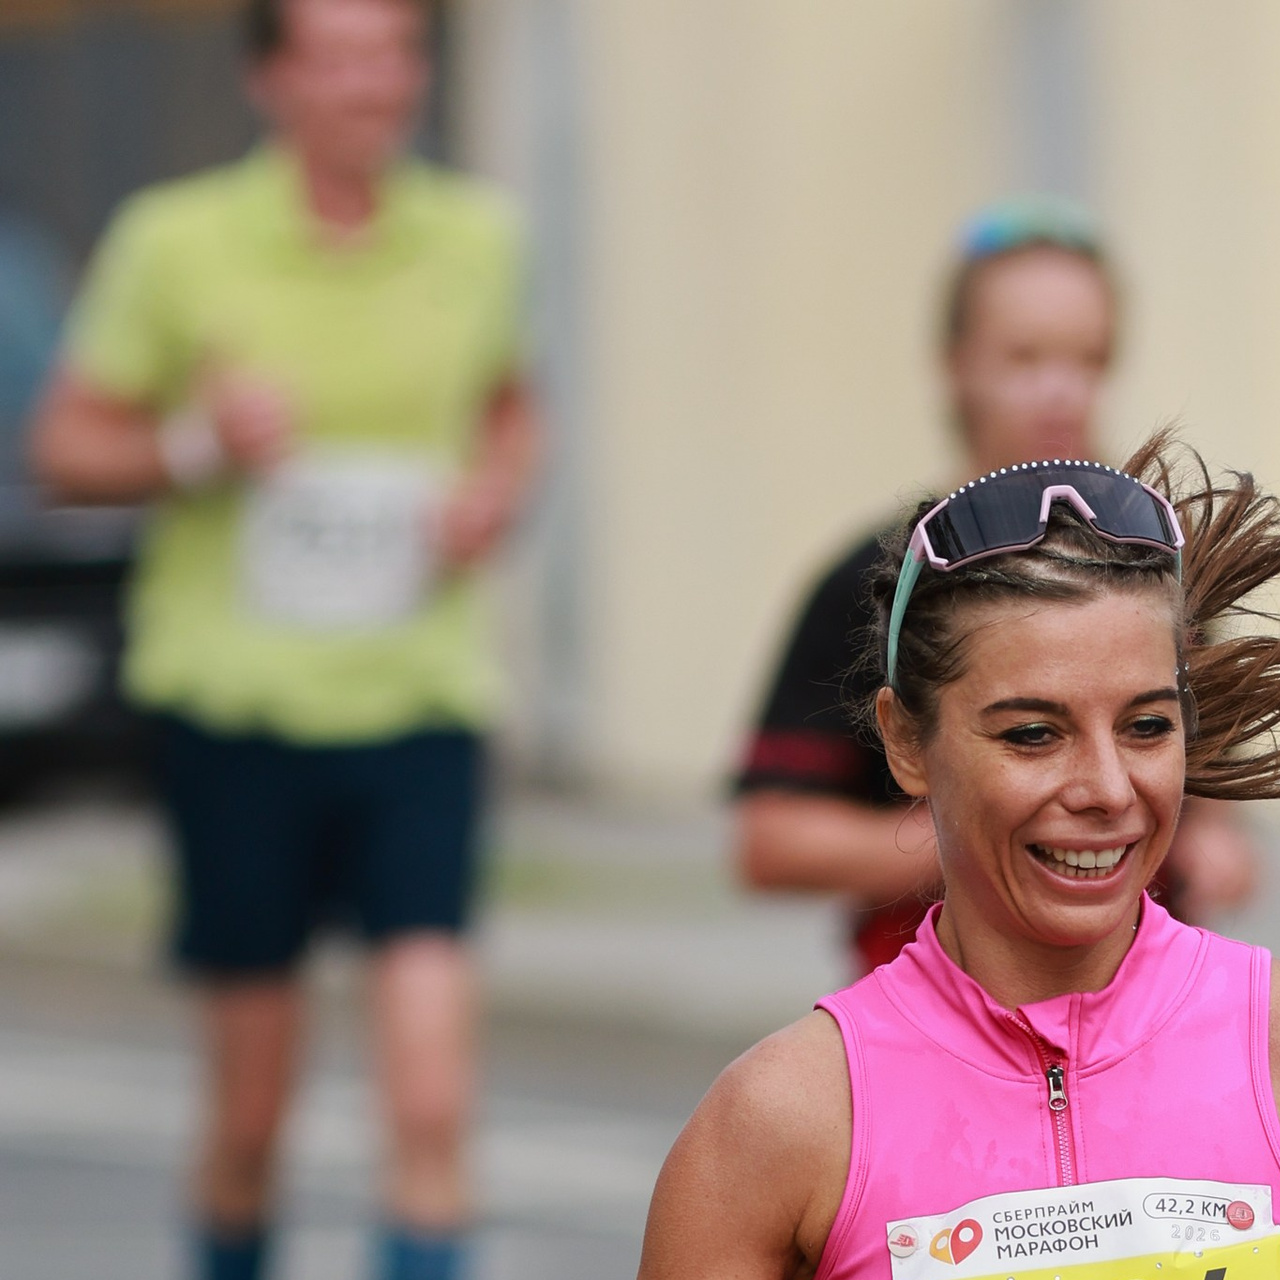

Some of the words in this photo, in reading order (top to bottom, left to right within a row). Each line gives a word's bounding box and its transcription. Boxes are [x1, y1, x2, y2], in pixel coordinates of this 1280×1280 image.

[993, 1201, 1094, 1223] СБЕРПРАЙМ
[1155, 1198, 1195, 1215] 42,2
[995, 1209, 1133, 1241] МОСКОВСКИЙ
[1171, 1224, 1220, 1241] 2026
[997, 1235, 1098, 1260] МАРАФОН
